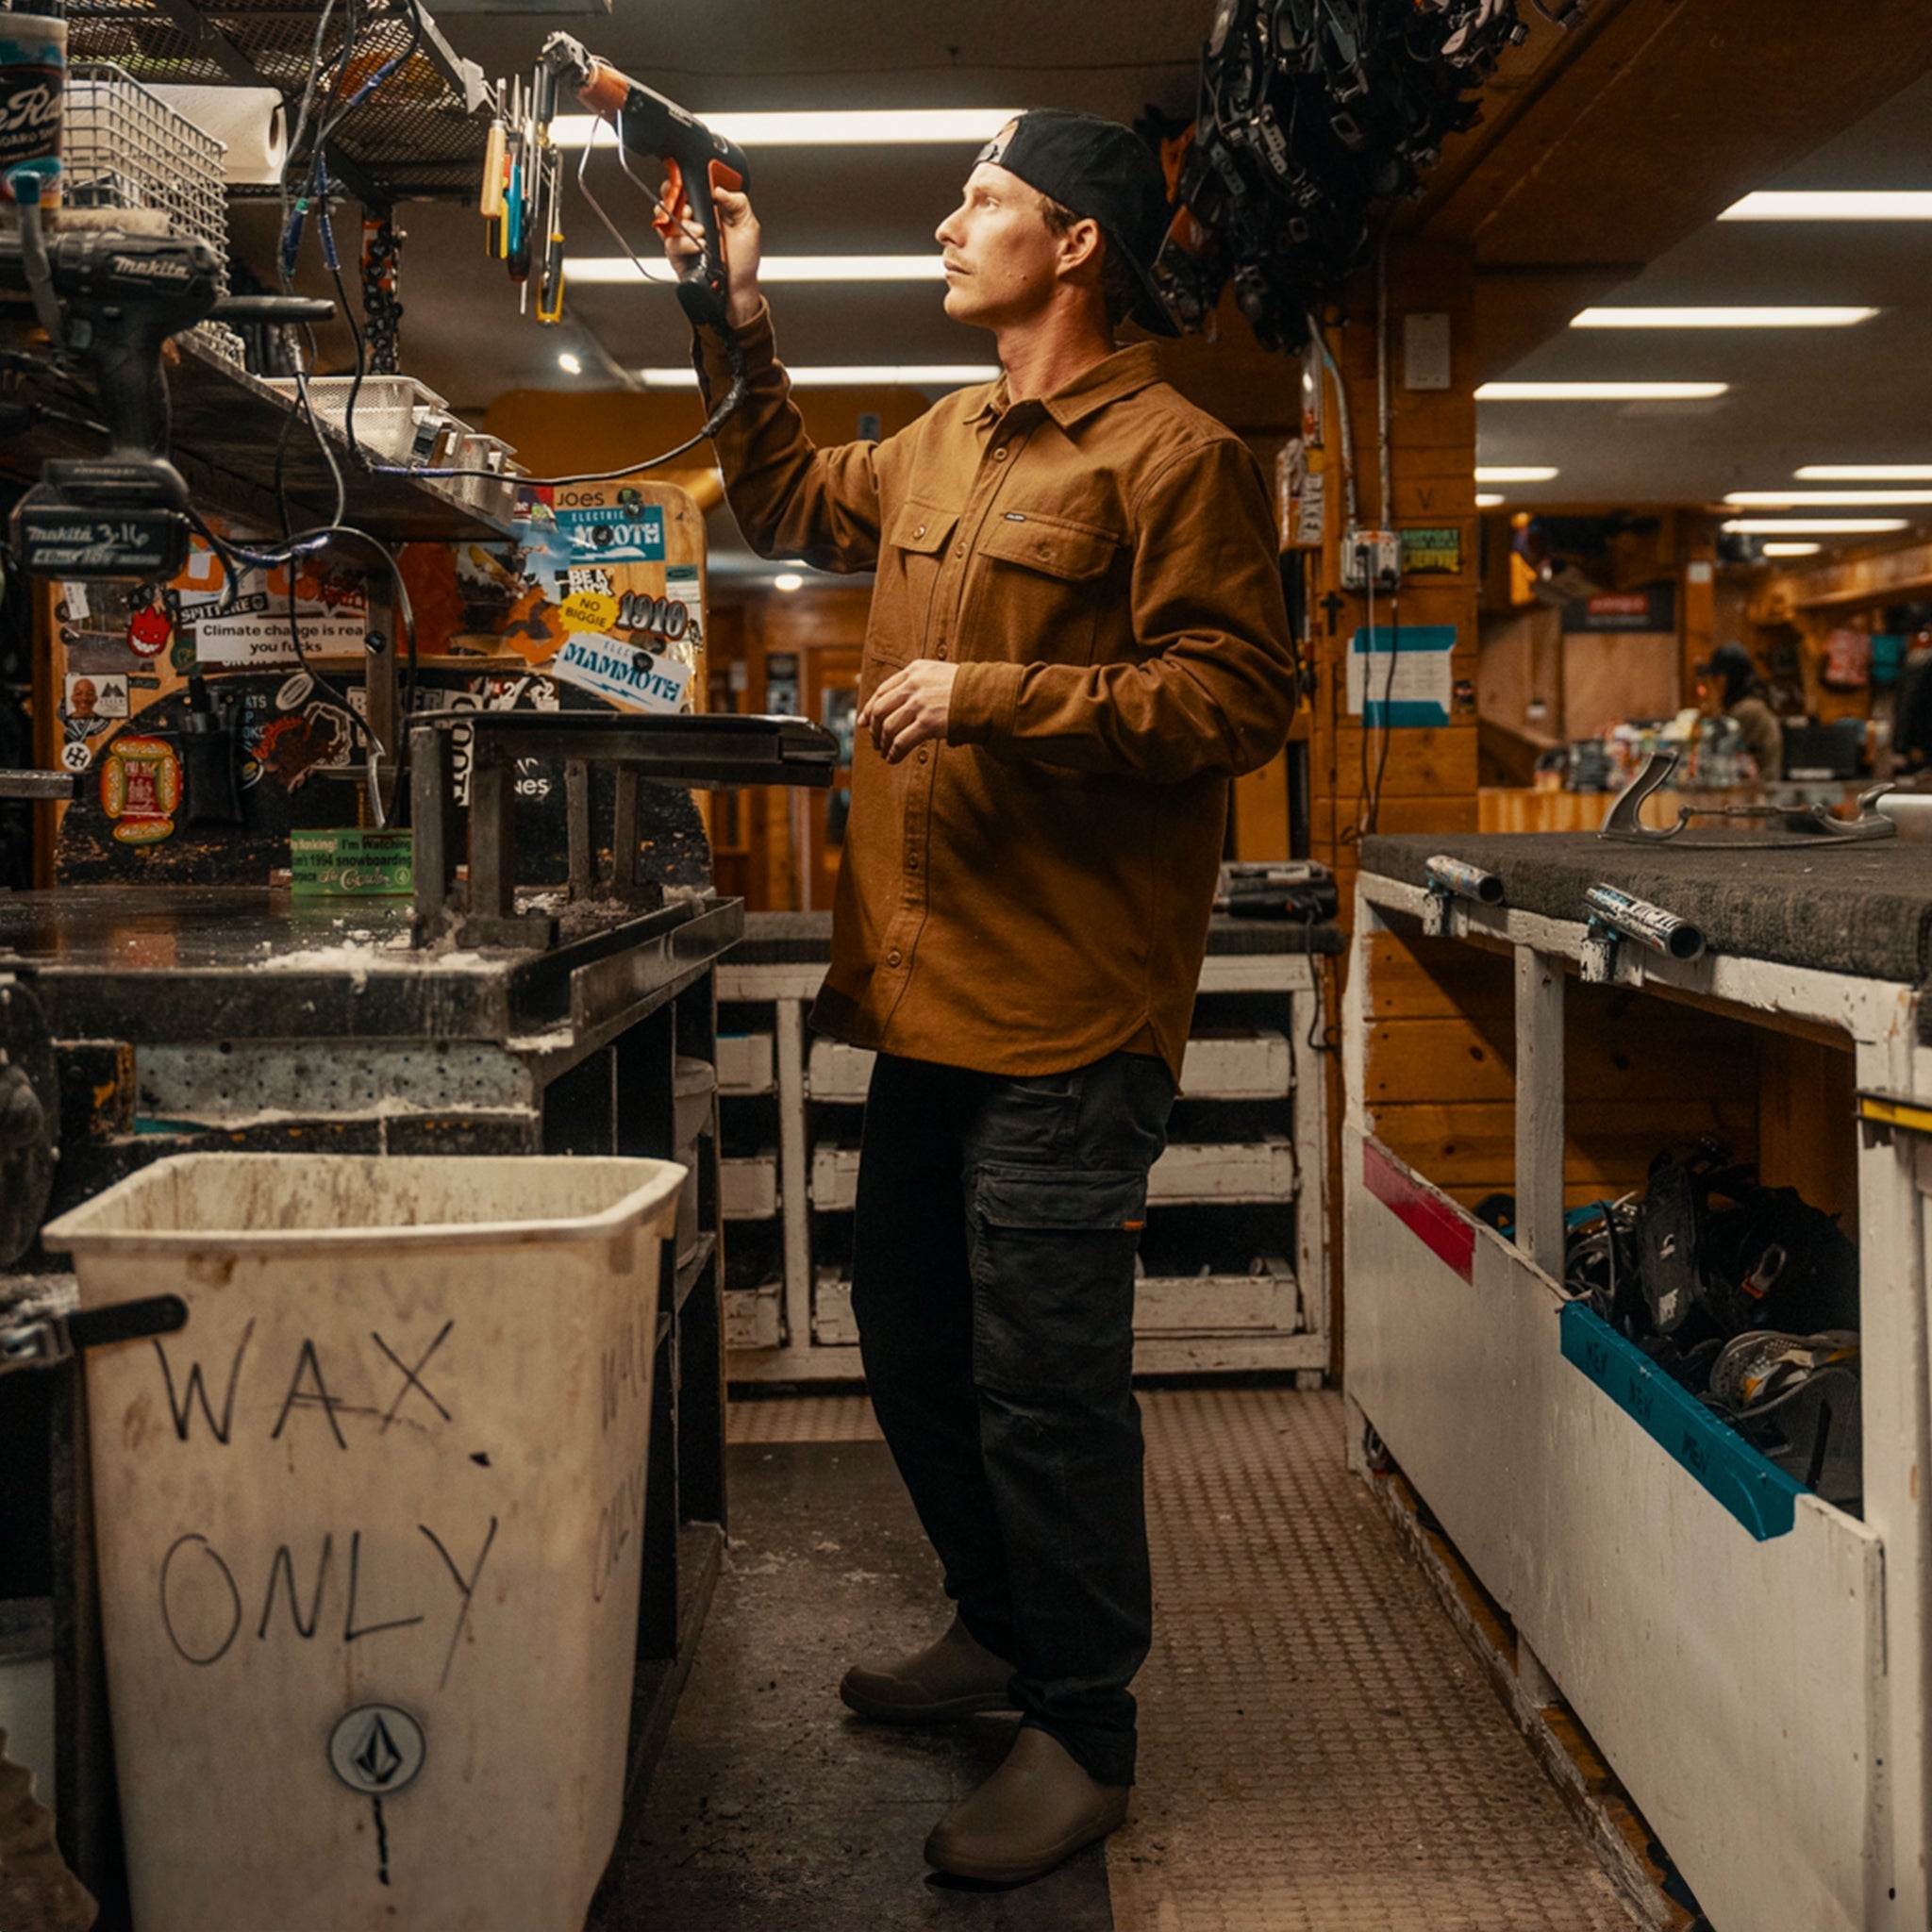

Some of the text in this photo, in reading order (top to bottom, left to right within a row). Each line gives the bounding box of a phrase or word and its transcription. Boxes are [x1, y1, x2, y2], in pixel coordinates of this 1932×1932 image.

[568, 570, 591, 586] BE
[579, 598, 601, 611] NO
[566, 607, 607, 627] BIGGIE
[616, 591, 688, 640] 1910
[203, 625, 261, 637] Climate
[323, 625, 335, 637] is
[338, 626, 365, 637] rea
[249, 643, 277, 656] you
[563, 642, 680, 702] MAMMOTH
[336, 854, 412, 868] snowboarding
[153, 1318, 455, 1451] WAX
[160, 1515, 498, 1692] ONLY
